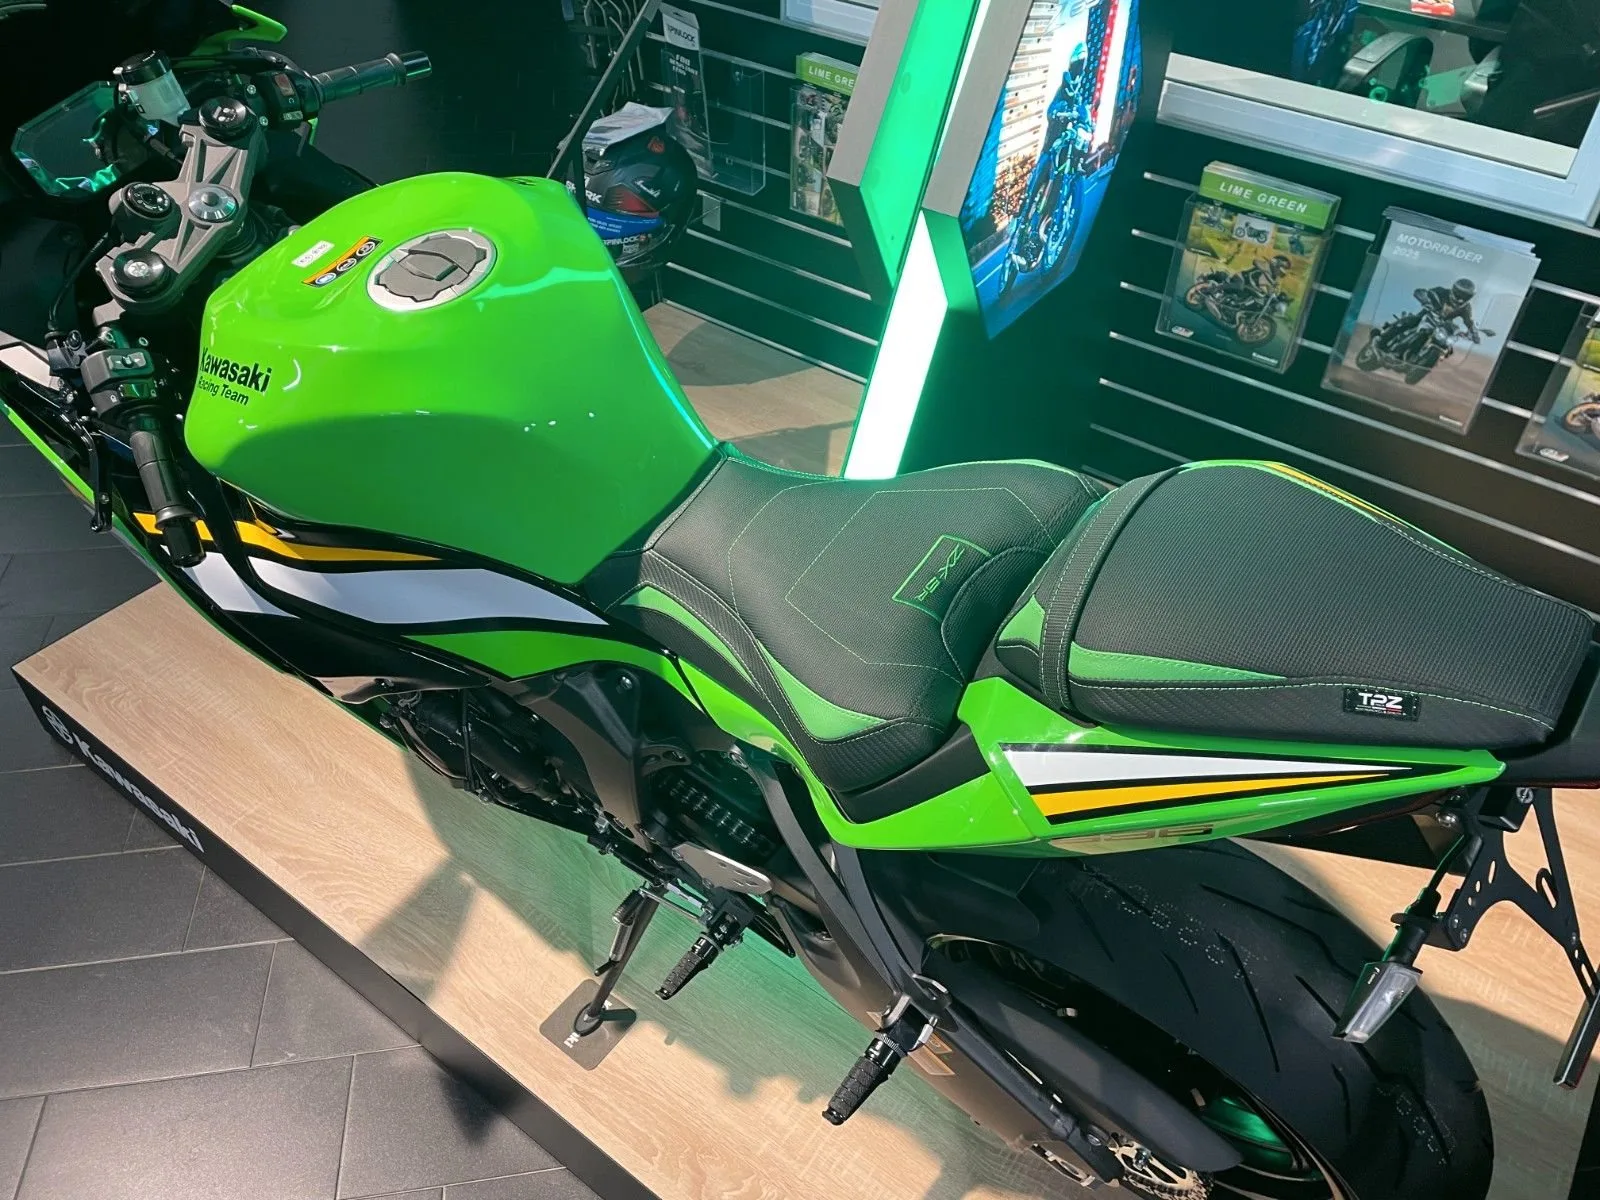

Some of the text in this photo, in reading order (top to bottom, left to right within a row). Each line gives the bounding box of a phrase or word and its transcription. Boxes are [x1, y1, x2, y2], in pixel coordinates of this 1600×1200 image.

[808, 66, 832, 81] LIME
[834, 74, 855, 88] GRE
[1219, 181, 1253, 200] LIME
[1257, 192, 1308, 213] GREEN
[200, 346, 273, 393] Kawasaki
[198, 375, 249, 406] Racing Team
[1358, 692, 1403, 709] TPZ
[72, 732, 205, 853] Kawasaki
